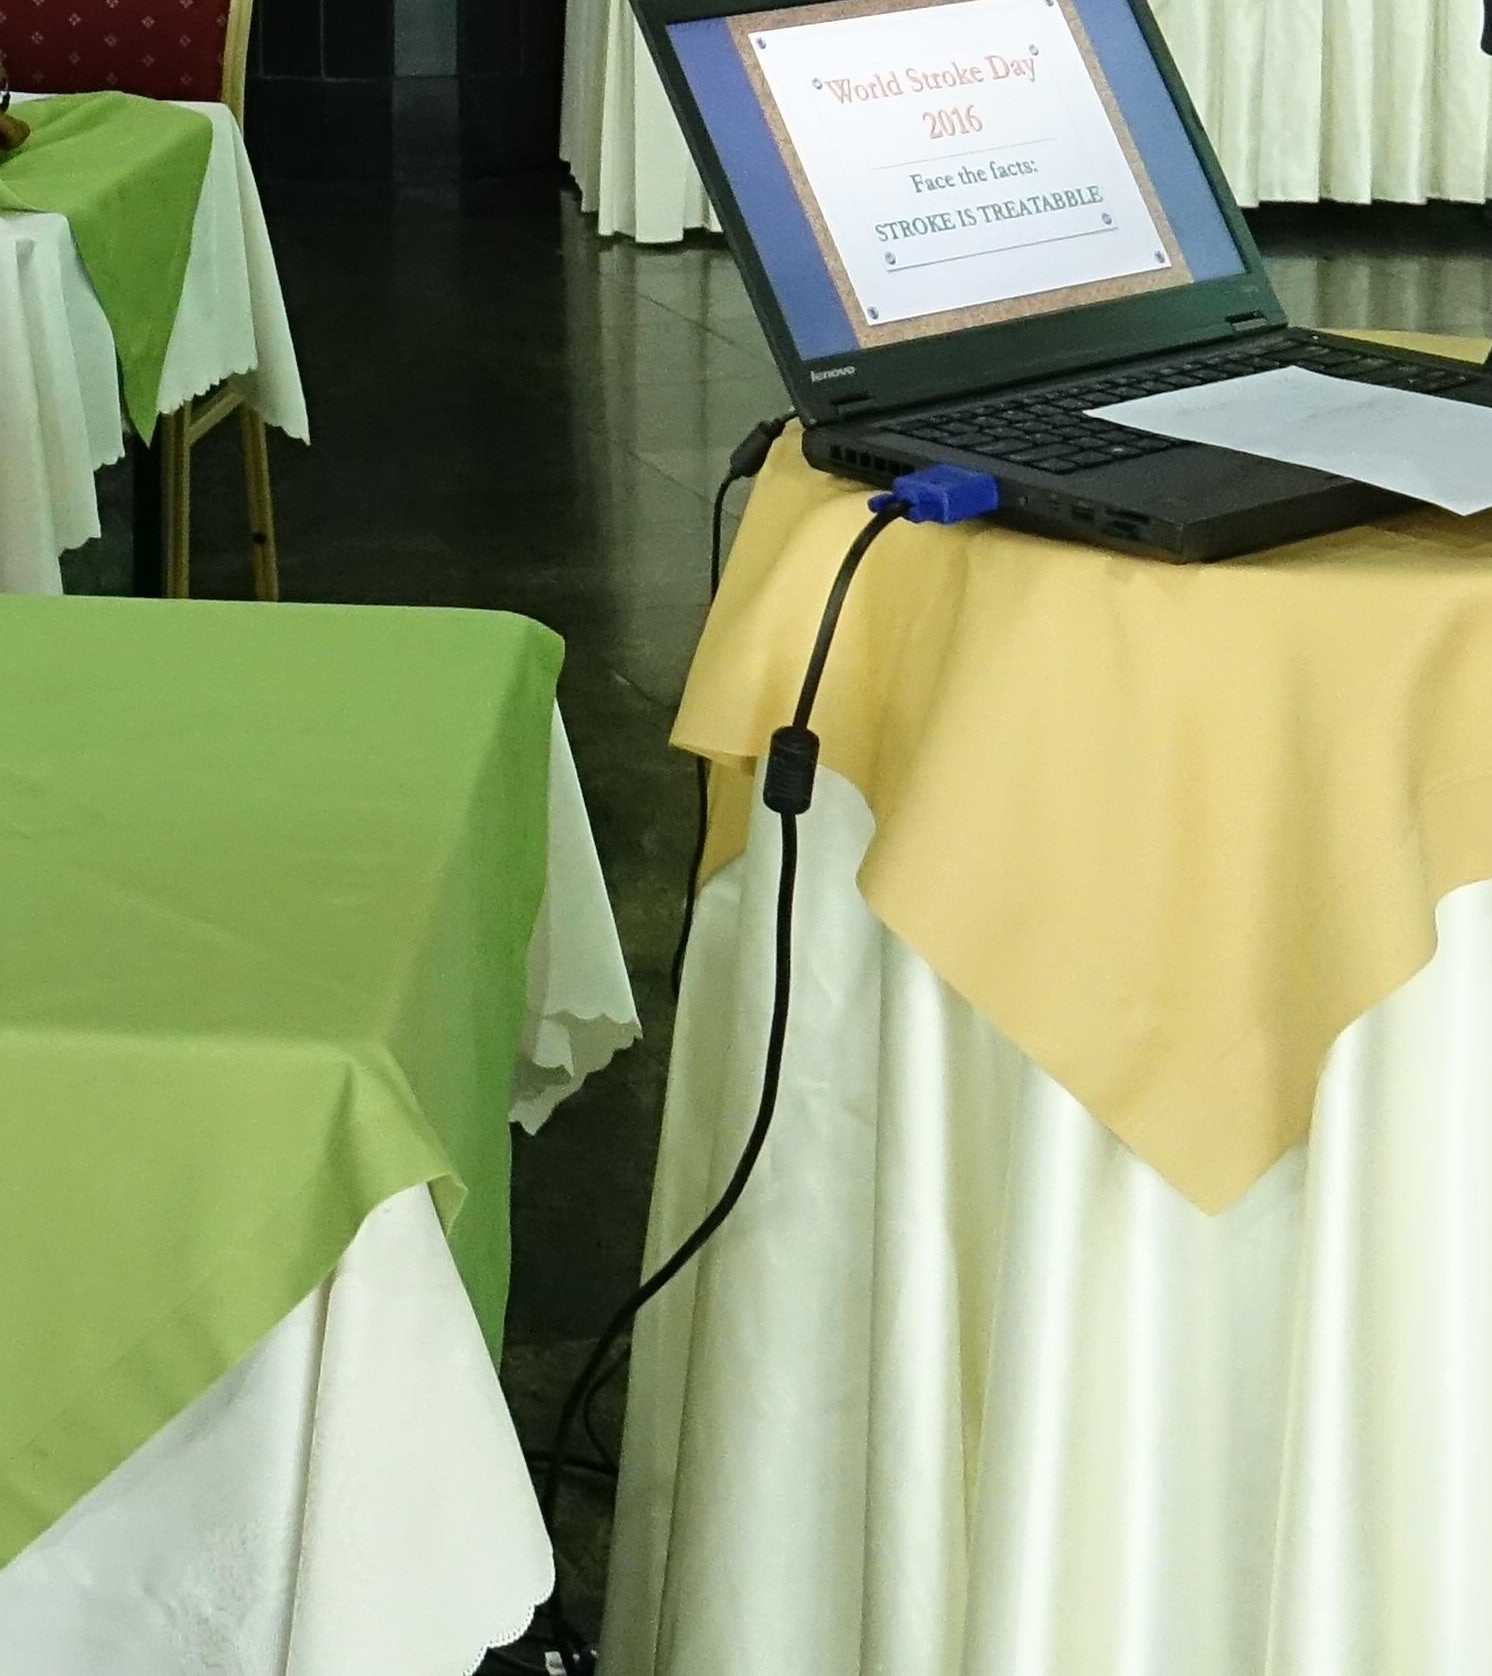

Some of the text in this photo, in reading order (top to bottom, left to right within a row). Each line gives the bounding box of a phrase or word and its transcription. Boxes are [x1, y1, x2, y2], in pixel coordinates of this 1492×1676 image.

[824, 54, 1037, 104] World Stroke Day
[922, 105, 983, 139] 2016
[910, 159, 1038, 193] Face the facts:
[875, 185, 1103, 242] STROKE IS TREATABBLE
[810, 365, 856, 383] lenovo
